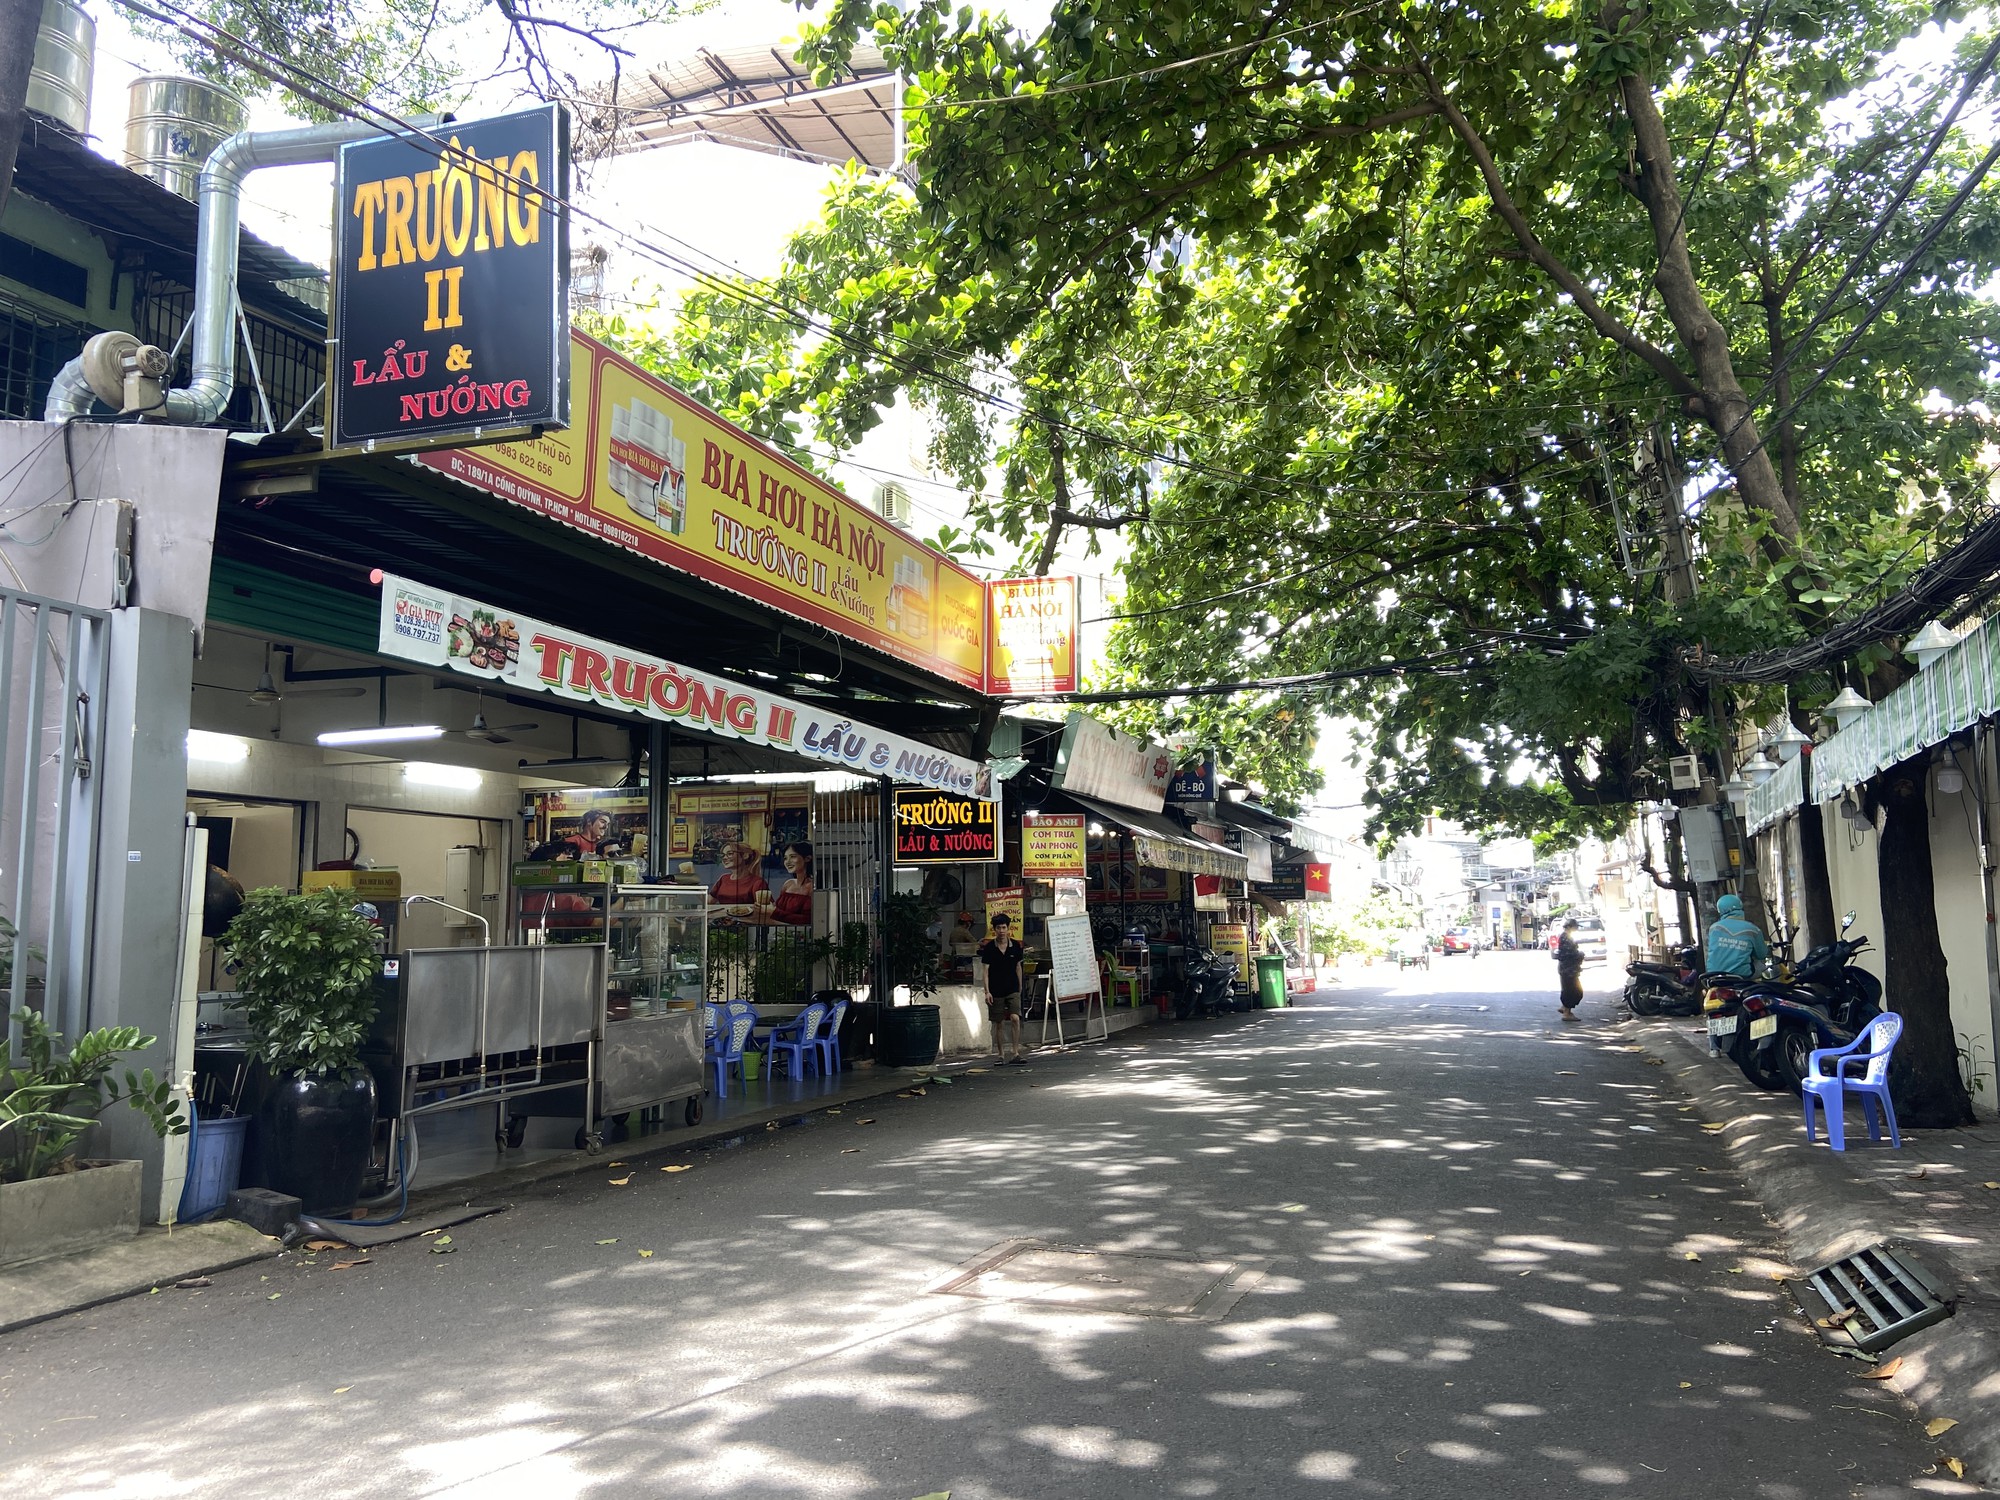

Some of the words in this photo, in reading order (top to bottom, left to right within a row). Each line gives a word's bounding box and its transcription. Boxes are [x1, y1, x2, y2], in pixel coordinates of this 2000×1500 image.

[423, 266, 464, 331] II
[352, 339, 429, 386] LẨU
[445, 344, 472, 371] &
[400, 375, 532, 421] NƯỚNG
[495, 443, 517, 460] 0983
[519, 452, 535, 469] 622
[537, 461, 553, 476] 656
[537, 440, 556, 459] THỦ
[451, 457, 465, 473] ĐC:
[467, 464, 494, 486] 189/1A
[495, 475, 516, 495] CỐNG
[544, 497, 569, 518] TP.HCM
[574, 510, 602, 531] HOTLINE:
[701, 437, 752, 508] BIA
[757, 470, 806, 536] HƠI
[811, 501, 844, 556] HÀ
[848, 522, 886, 581] NỘI
[712, 509, 808, 587] TRƯỜNG
[812, 559, 828, 597] II
[1008, 586, 1029, 599] BIA
[409, 604, 424, 620] GIA
[425, 609, 443, 625] HUY
[1000, 601, 1026, 619] HÀ
[941, 614, 965, 640] QUỐC
[966, 627, 980, 648] GIA
[530, 633, 758, 735] TRƯỜNG
[766, 702, 796, 745] II
[803, 720, 868, 761] LẨU
[870, 743, 890, 768] &
[894, 750, 973, 791] NƯỚNG
[1193, 779, 1205, 792] BÒ
[900, 796, 973, 825] TRƯỜNG
[978, 801, 992, 824] II
[1056, 818, 1078, 826] ANH
[899, 827, 925, 851] LẨU
[930, 835, 940, 851] &
[944, 830, 993, 851] NƯỚNG
